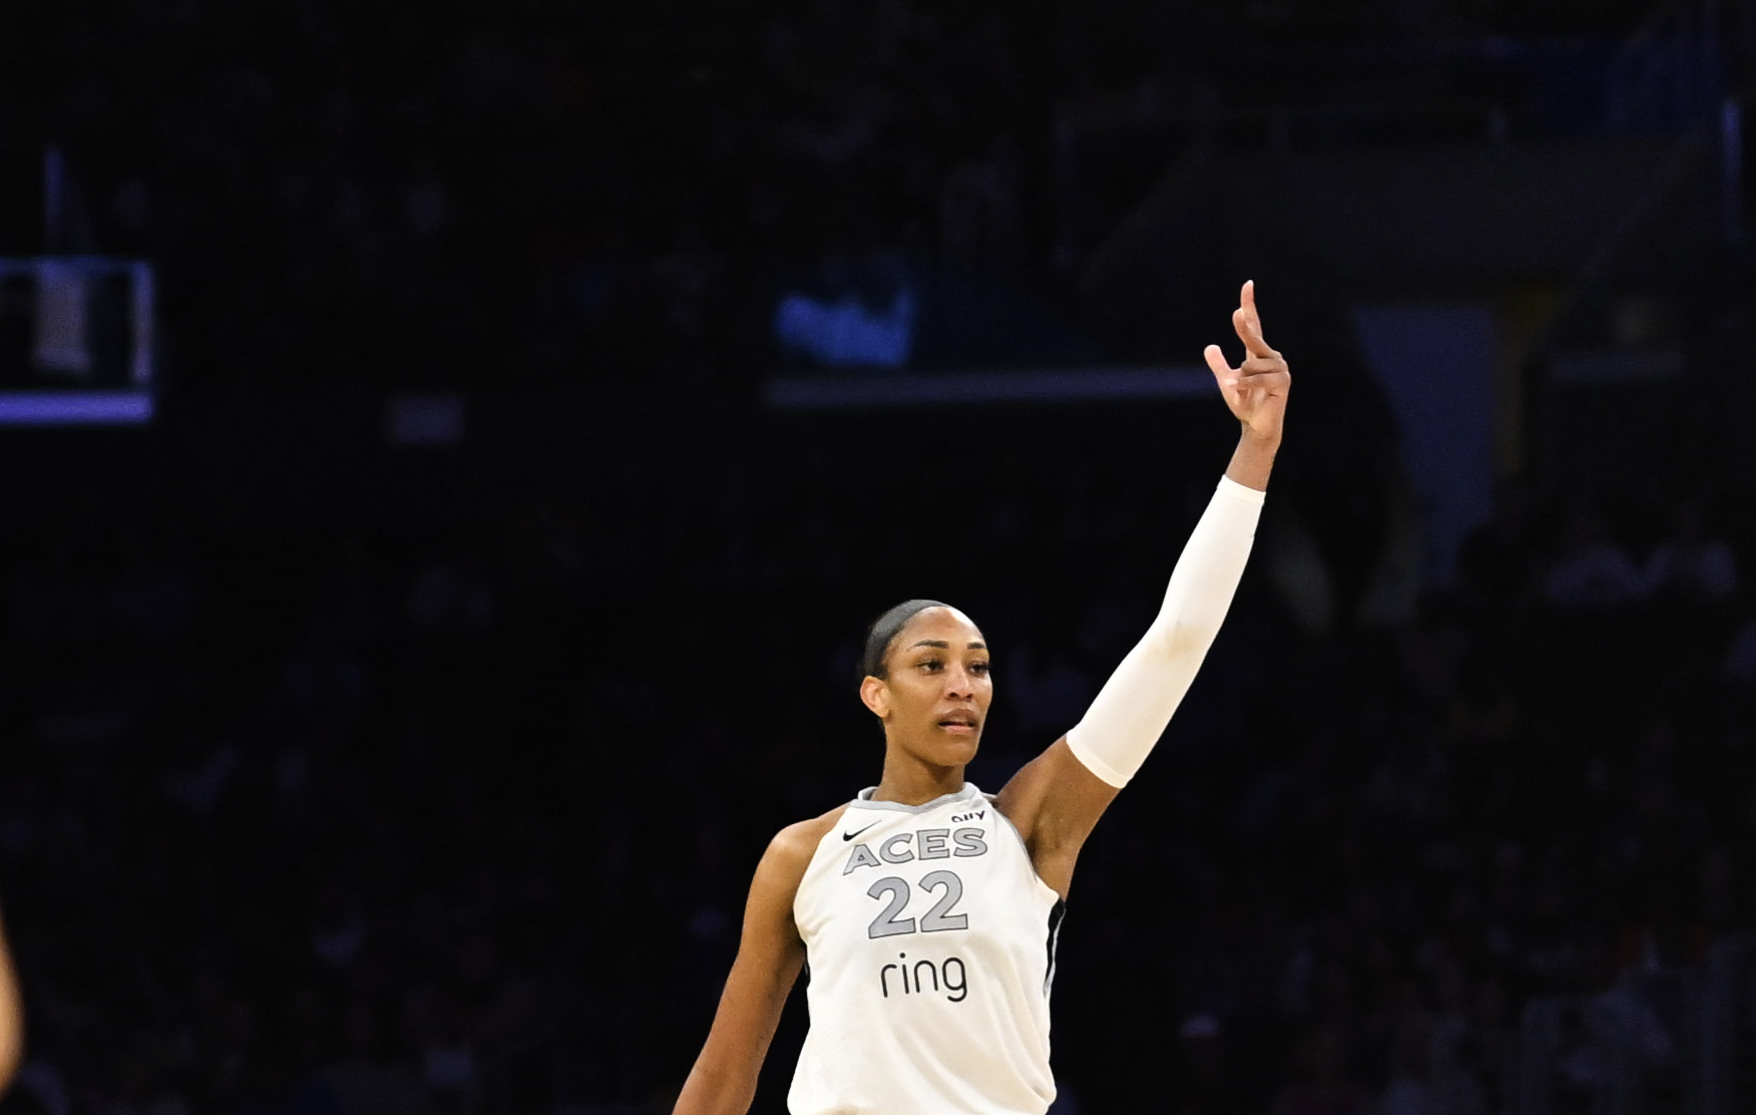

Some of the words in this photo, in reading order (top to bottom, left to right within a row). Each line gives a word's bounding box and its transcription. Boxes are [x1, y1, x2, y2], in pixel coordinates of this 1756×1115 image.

[842, 827, 988, 876] ACES
[866, 869, 969, 940] 22
[880, 952, 969, 1003] ring
